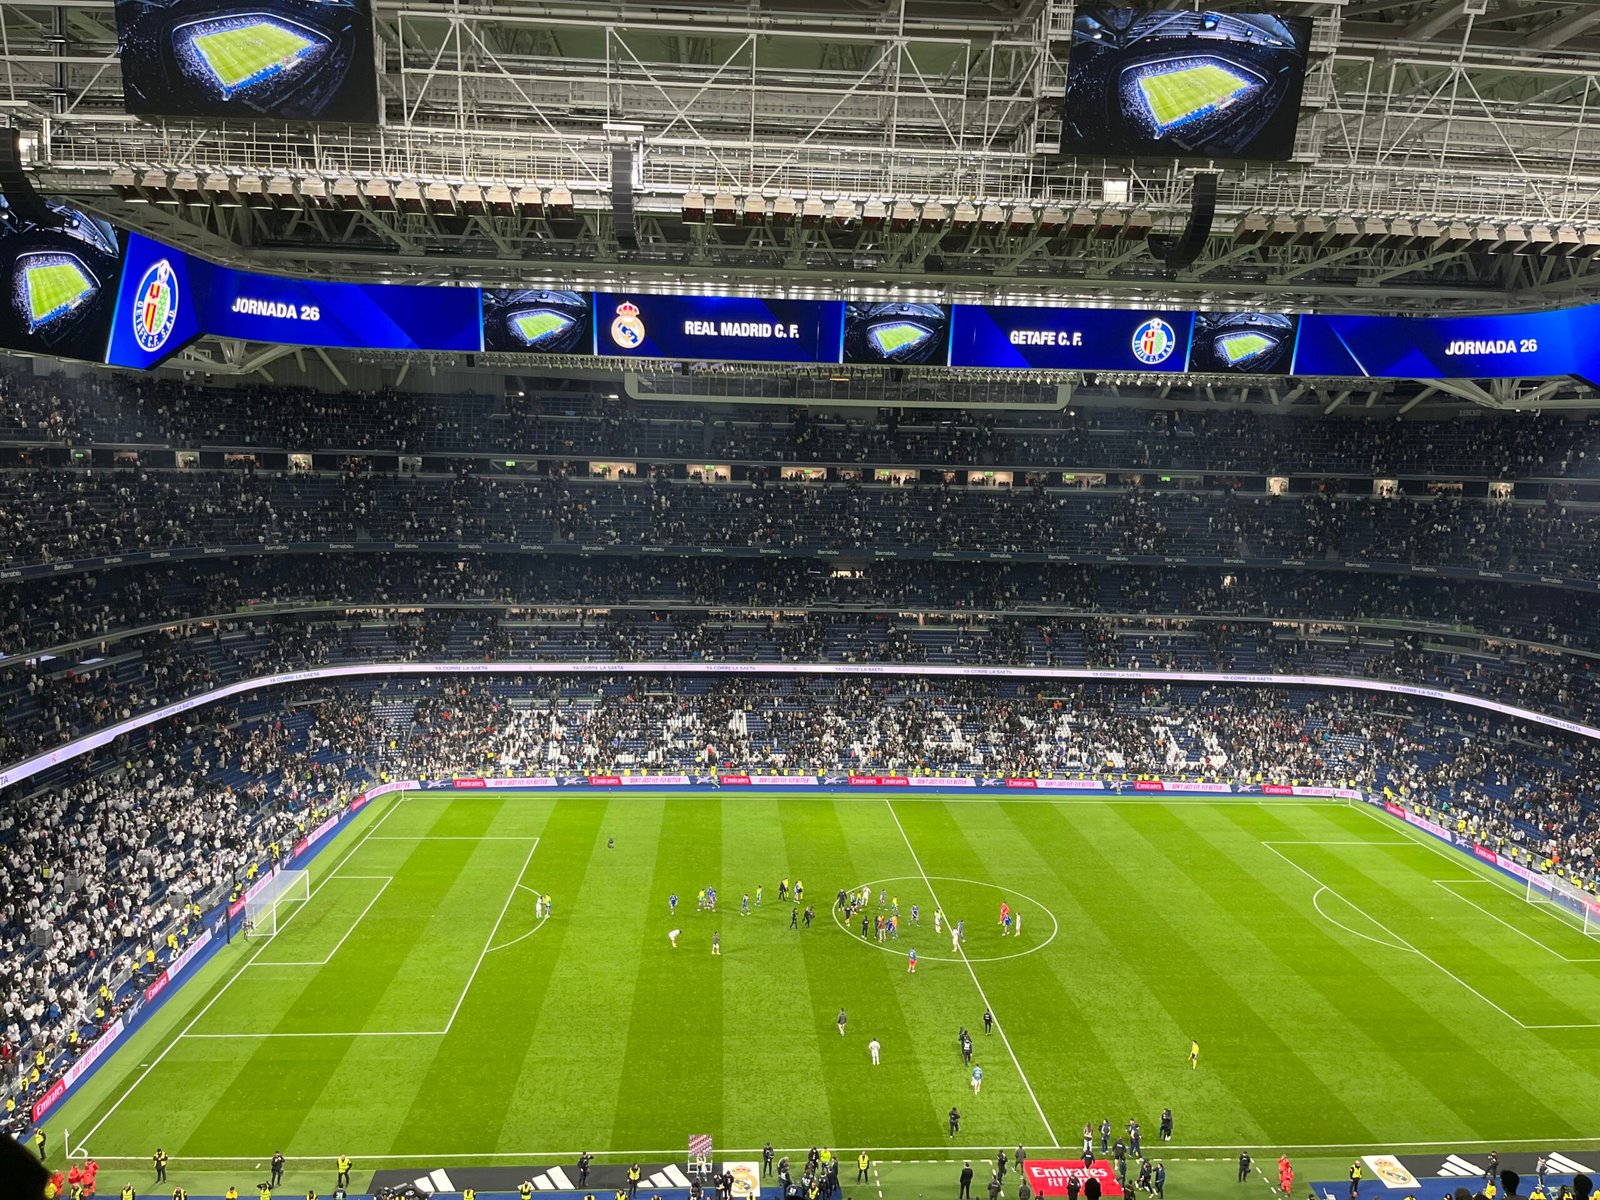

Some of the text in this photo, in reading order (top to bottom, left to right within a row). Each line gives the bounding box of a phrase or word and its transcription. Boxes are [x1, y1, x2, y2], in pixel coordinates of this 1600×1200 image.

[232, 298, 320, 320] JORNADA 26
[685, 321, 799, 338] REAL MADRID C. F.
[1010, 331, 1082, 346] GETAFE C. F.
[1445, 339, 1538, 355] JORNADA 26
[37, 1085, 62, 1116] Emirates
[1031, 1166, 1107, 1177] Emirates
[1048, 1178, 1064, 1187] FLY
